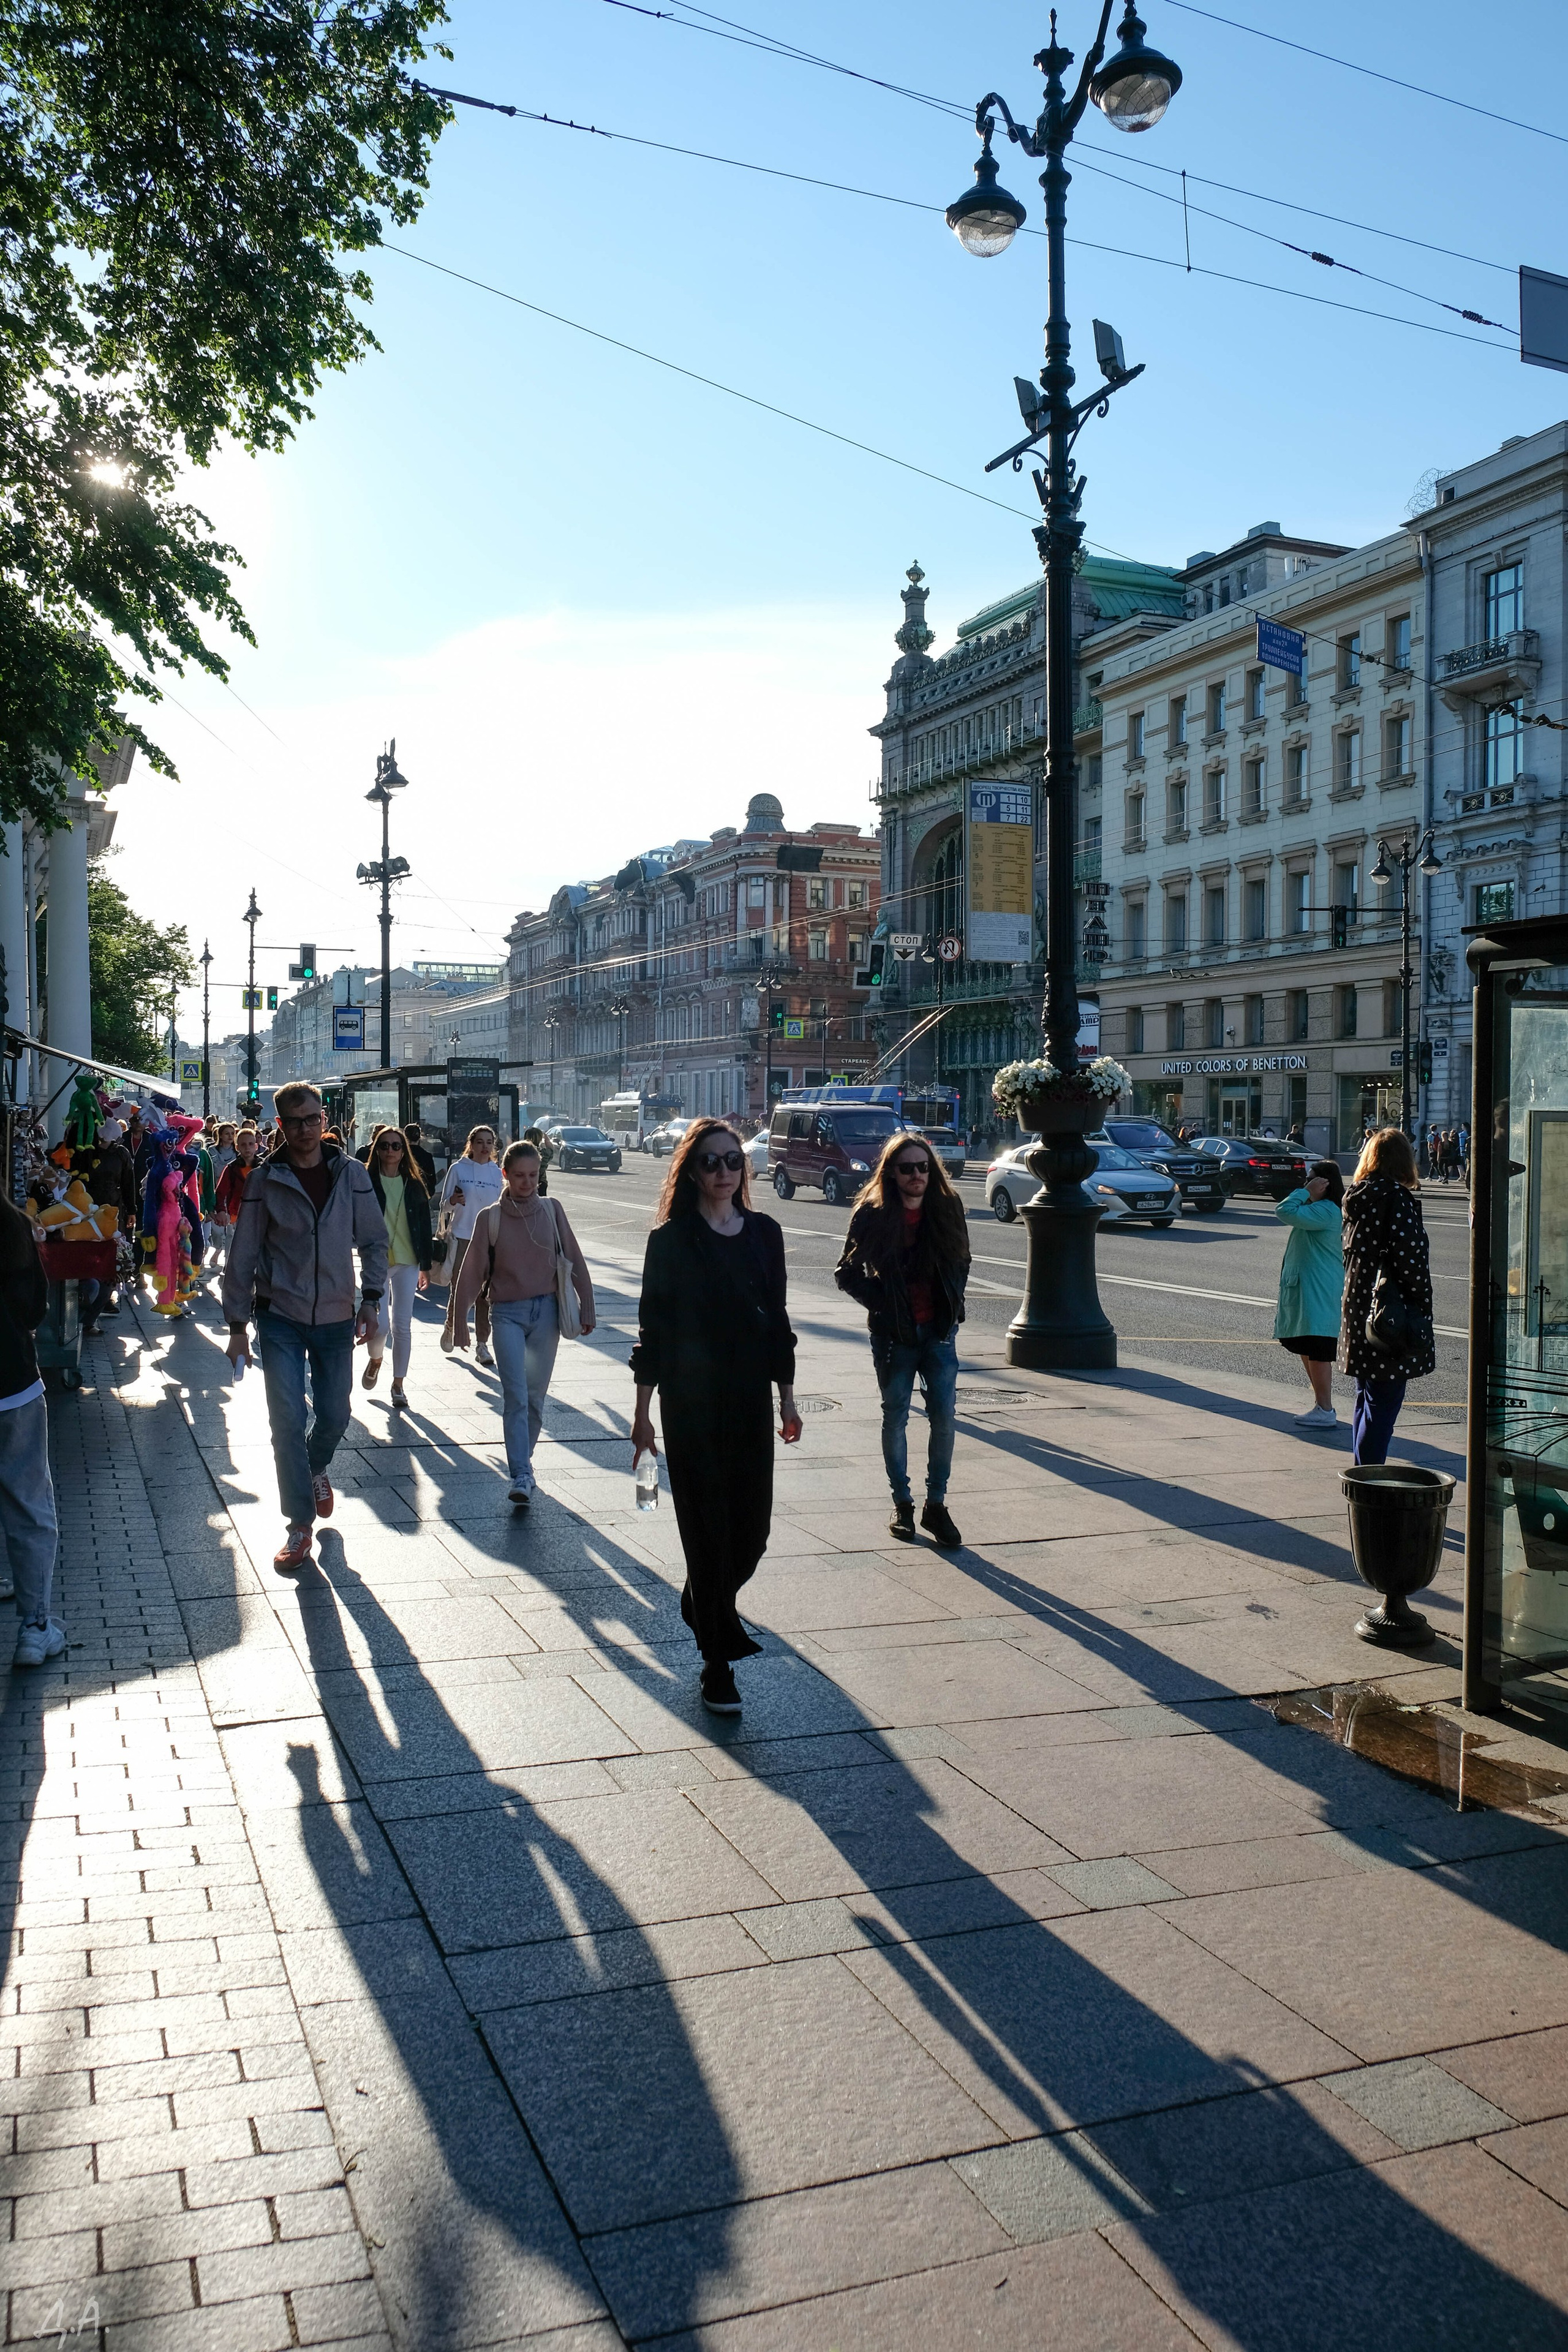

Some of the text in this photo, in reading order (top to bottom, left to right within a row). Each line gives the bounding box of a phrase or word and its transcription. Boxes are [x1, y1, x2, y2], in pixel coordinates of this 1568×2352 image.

[1262, 623, 1299, 644] ОСТАНОВКА
[1262, 642, 1299, 663] ТРОЛЛЕЙБУСОВ
[1262, 652, 1300, 672] ОДНОВРЕМЕННО
[894, 936, 918, 944] СТОП
[1161, 1056, 1308, 1074] UNITED COLORS OF BENETTON.
